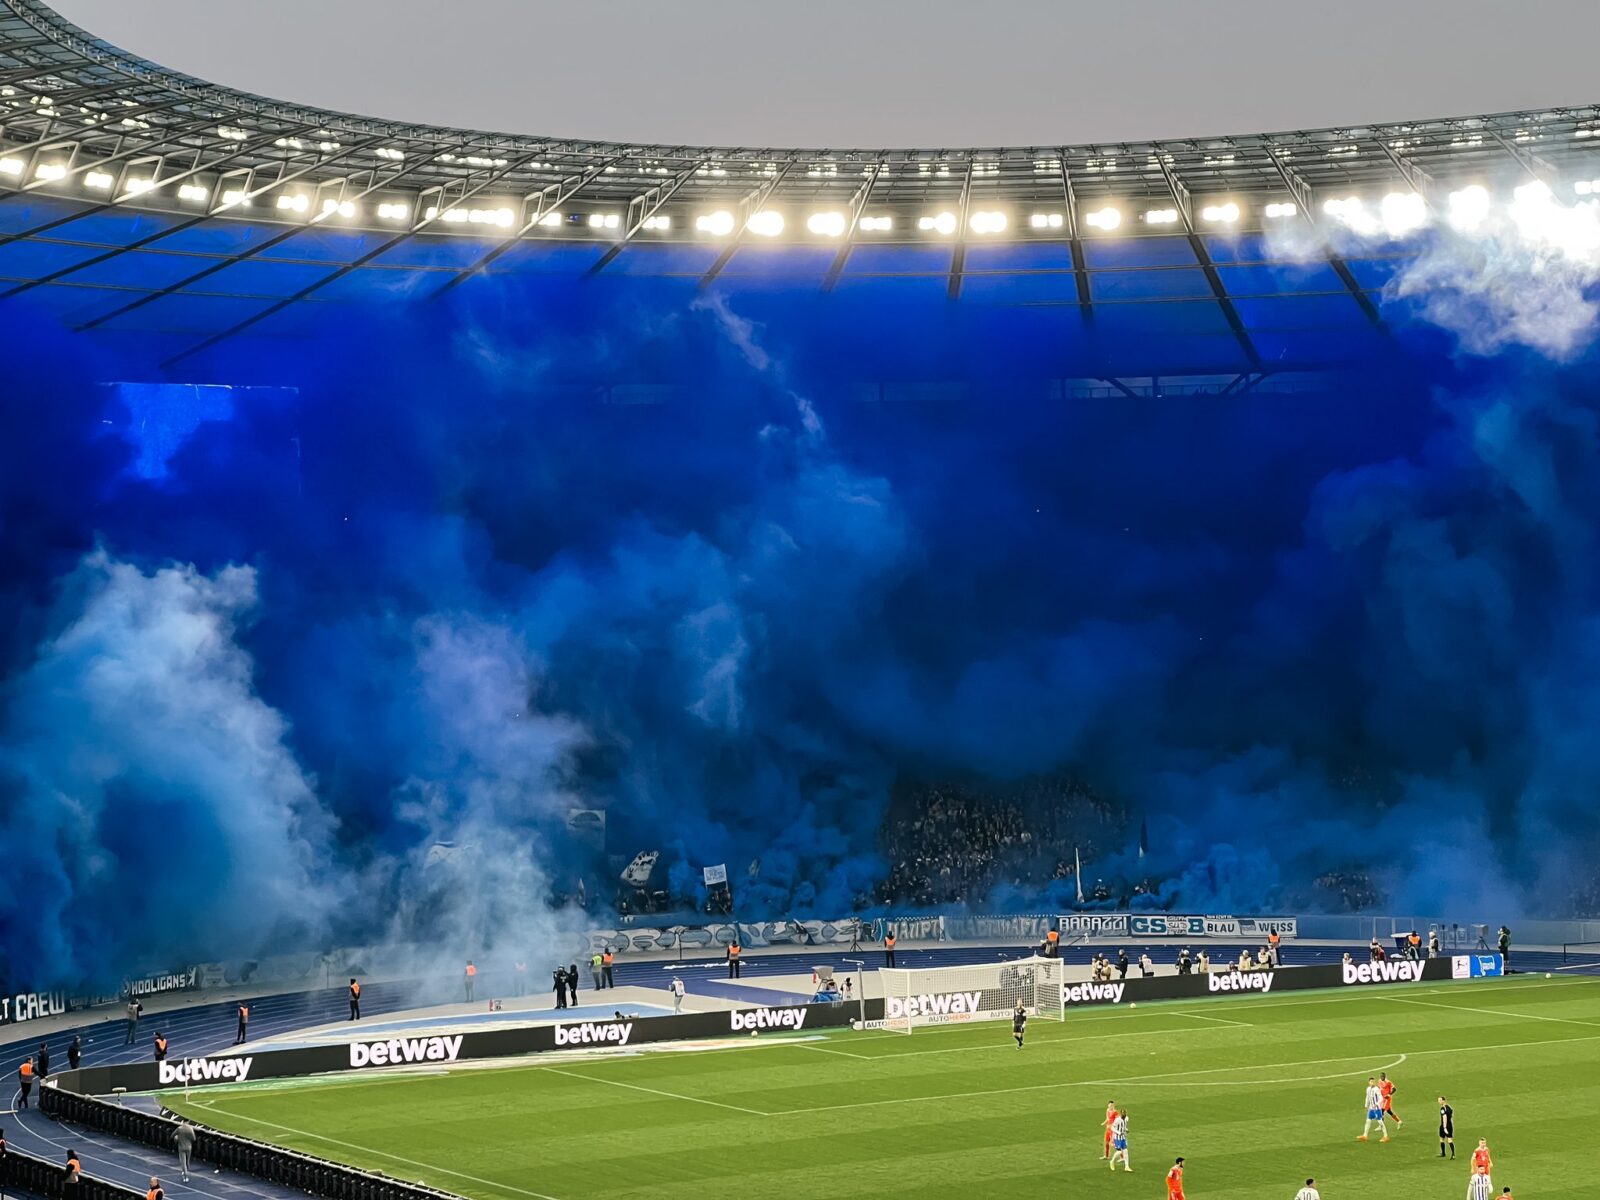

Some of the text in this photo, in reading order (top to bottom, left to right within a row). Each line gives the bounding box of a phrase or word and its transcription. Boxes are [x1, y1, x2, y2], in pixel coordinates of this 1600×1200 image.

[1207, 922, 1293, 933] BLAU WEISS
[1209, 972, 1275, 993] betway
[1343, 959, 1426, 984] betway
[131, 974, 186, 995] HOOLIGANS
[1063, 982, 1125, 1004] betway
[886, 991, 982, 1018] betway
[731, 1008, 807, 1031] betway
[928, 1013, 971, 1023] AUTOHERO
[554, 1022, 633, 1046] betway
[349, 1034, 464, 1068] betway
[159, 1056, 253, 1084] betway
